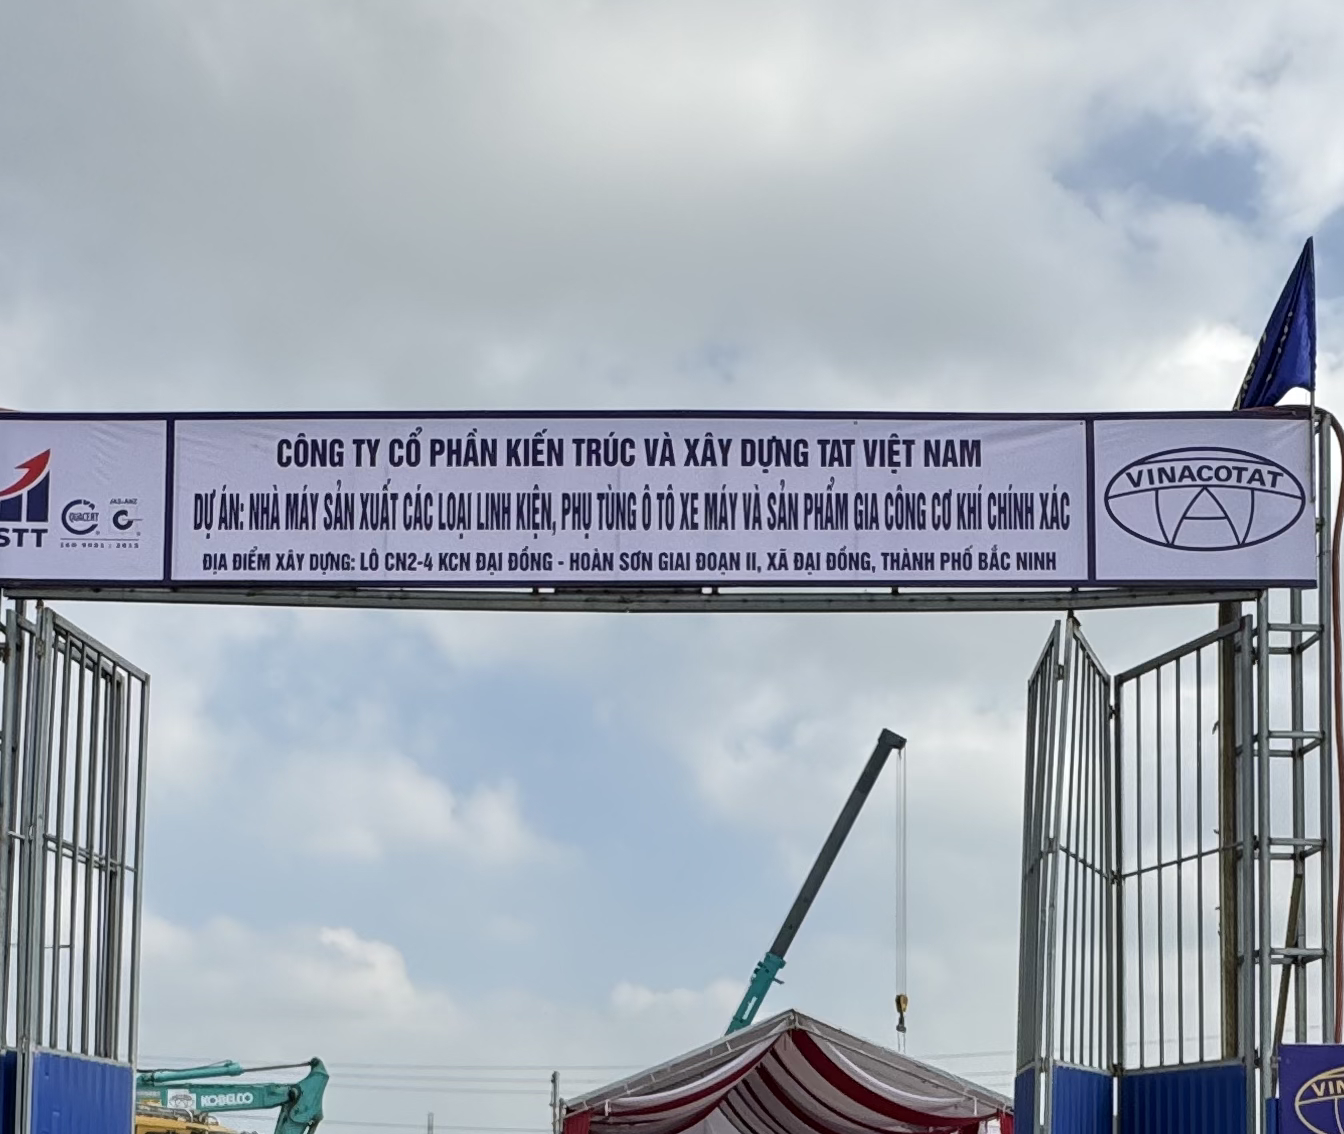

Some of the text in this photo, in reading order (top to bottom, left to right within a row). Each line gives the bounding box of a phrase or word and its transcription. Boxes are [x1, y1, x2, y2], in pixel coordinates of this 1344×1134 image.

[277, 428, 982, 474] CÔNG TY CỔ PHẦN KIẾN TRÚC VÀ XÂY DỰNG TAT VIỆT NAM
[1126, 465, 1284, 489] VINACOTAT
[194, 479, 1070, 539] DỰ ÁN: NHÀ MÁY SẢN XUẤT CÁC LOẠI LINH KIỆN, PHỤ TÙNG Ô TÔ XE MÁY VÀ SẢN PHẨM GIA CÔNG CƠ KHÍ CHÍNH XÁC
[203, 553, 227, 575] ĐỊA
[232, 546, 270, 570] ĐIỂM
[275, 549, 304, 570] XÂY
[309, 551, 355, 575] DỰNG:
[360, 549, 379, 570] LÔ
[385, 553, 433, 570] CN2-4
[439, 553, 470, 570] KCN
[476, 553, 502, 575] ĐẠI
[508, 546, 552, 570] ĐỒNG
[570, 549, 614, 570] HOÀN
[619, 551, 653, 570] SƠN
[658, 553, 690, 570] GIAI
[696, 553, 740, 575] ĐOẠN
[746, 553, 761, 573] II,
[767, 549, 788, 570] XÃ
[794, 553, 820, 575] ĐẠI
[826, 546, 876, 573] ĐỒNG,
[881, 549, 935, 570] THÀNH
[940, 546, 973, 570] PHỐ
[978, 546, 1011, 570] BẮC
[1016, 553, 1056, 570] NINH
[200, 1092, 254, 1107] KOBELCO
